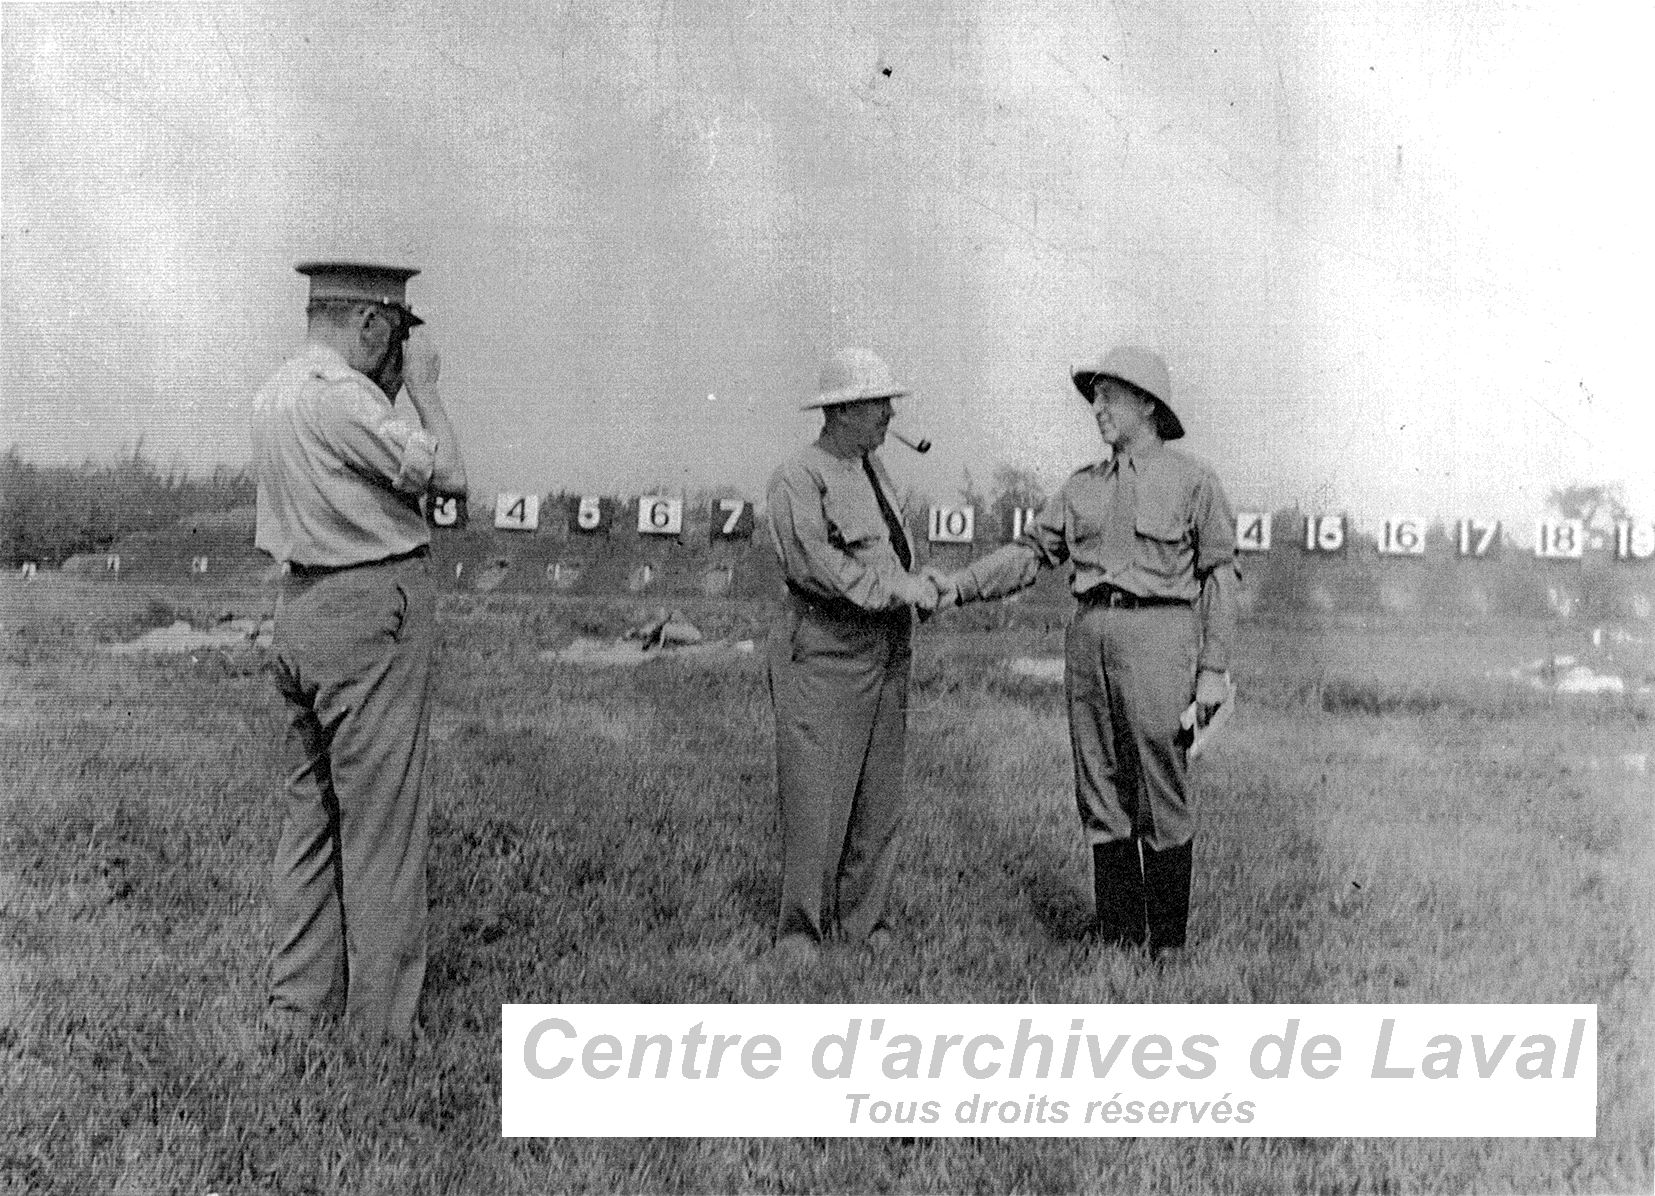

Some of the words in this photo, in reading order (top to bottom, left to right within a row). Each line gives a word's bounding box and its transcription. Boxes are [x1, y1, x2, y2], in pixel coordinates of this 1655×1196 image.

[434, 497, 457, 526] 3
[506, 499, 528, 523] 4
[578, 496, 601, 529] 5
[651, 503, 669, 527] 6
[719, 499, 745, 534] 7
[934, 512, 966, 535] 10
[1243, 519, 1264, 544] 4
[1306, 516, 1344, 551] 15
[1383, 522, 1420, 550] 16
[1459, 520, 1500, 555] 17
[1541, 523, 1575, 552] 18
